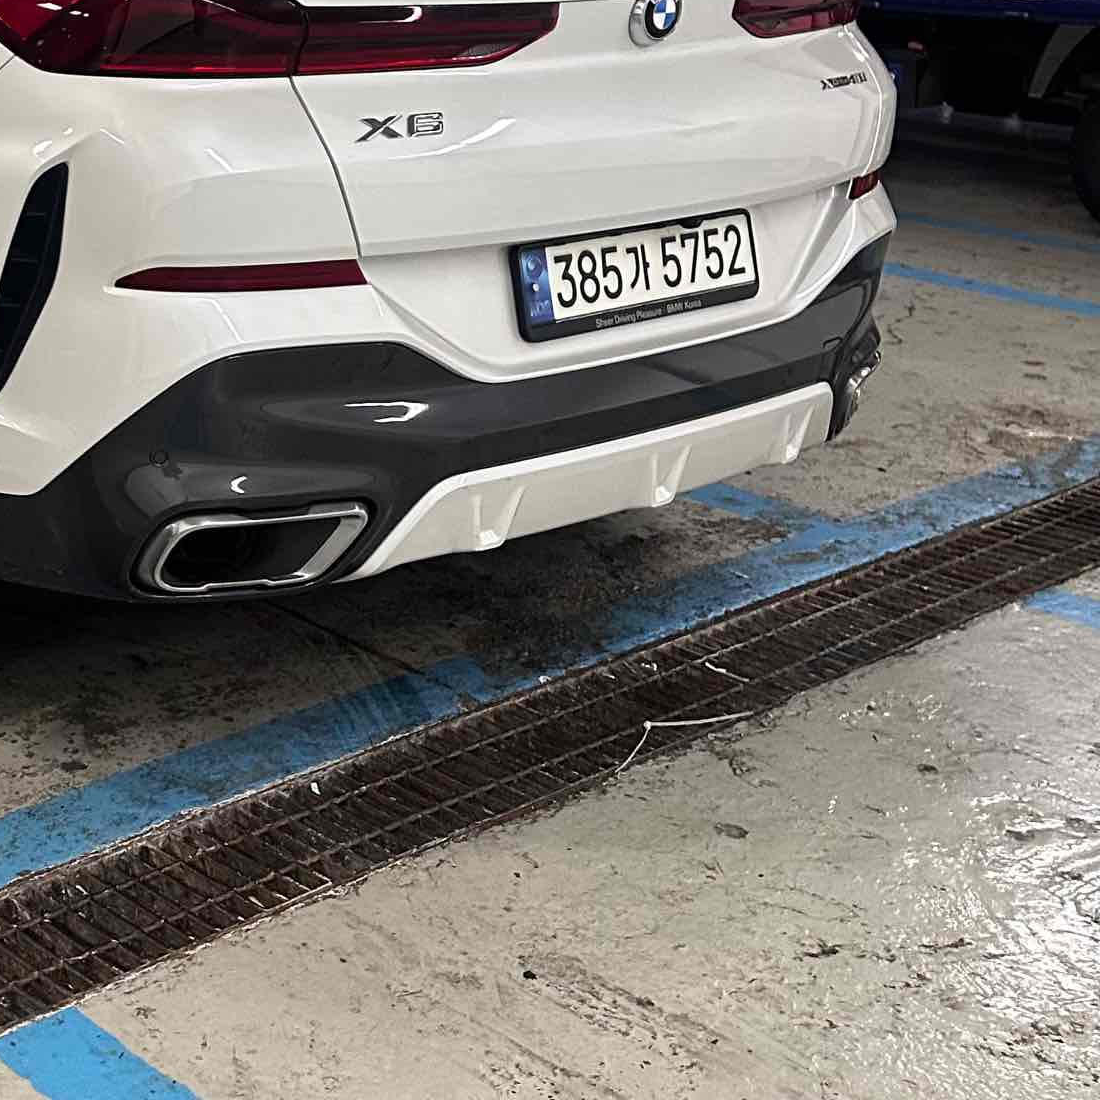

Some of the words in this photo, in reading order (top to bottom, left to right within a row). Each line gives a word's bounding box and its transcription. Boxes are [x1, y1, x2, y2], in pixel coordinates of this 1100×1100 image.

[354, 111, 444, 143] X6
[553, 243, 651, 308] 385가
[660, 223, 746, 288] 5752
